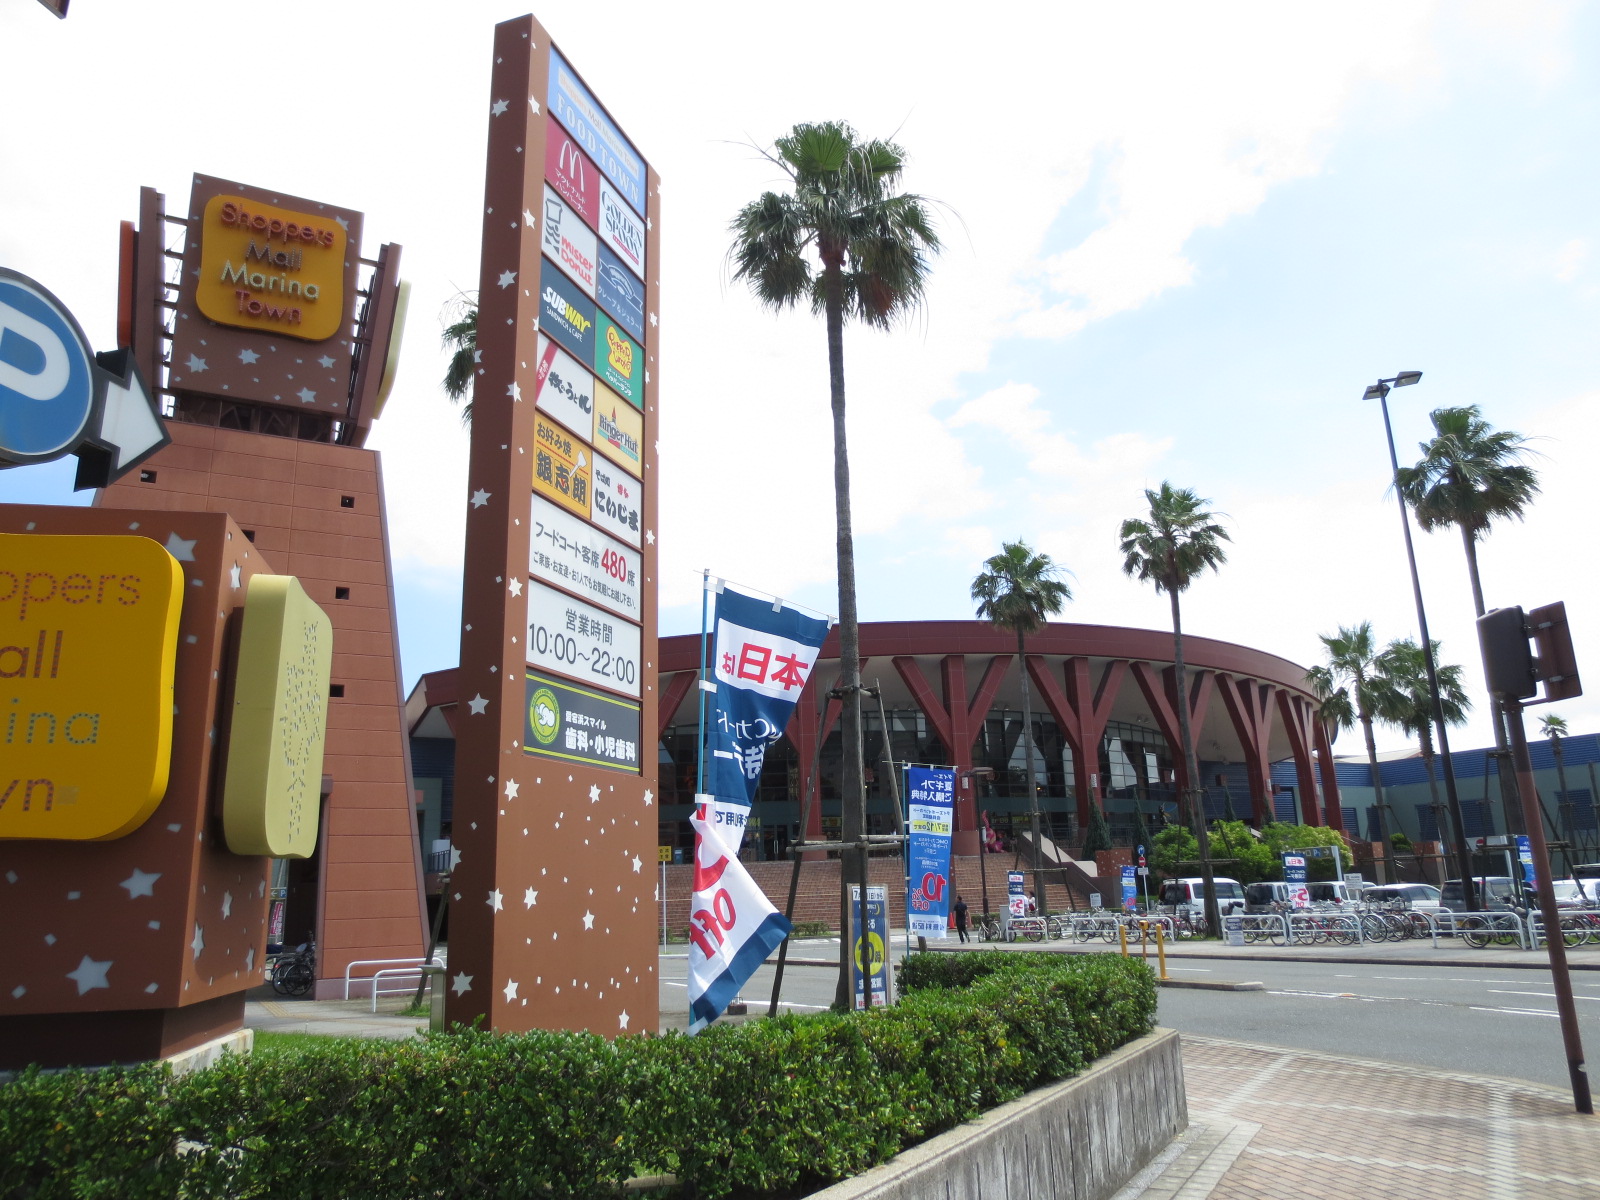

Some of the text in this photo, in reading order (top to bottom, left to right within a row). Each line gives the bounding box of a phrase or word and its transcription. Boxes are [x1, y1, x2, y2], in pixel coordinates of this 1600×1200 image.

[587, 108, 602, 128] Mall
[556, 92, 596, 150] FOOD
[600, 143, 638, 204] TOWN
[221, 202, 335, 248] Shoppers
[602, 190, 642, 248] GOLDEN
[606, 212, 640, 259] SPOON
[246, 240, 302, 271] Mall
[220, 260, 320, 300] Marina
[236, 290, 302, 323] Town
[543, 287, 591, 332] SUBWAY
[546, 306, 568, 330] SANDWICH
[572, 328, 582, 342] CAFE
[536, 422, 572, 458] お好み焼
[599, 412, 624, 444] Ringer
[624, 430, 638, 453] Hut
[595, 488, 638, 532] にいじま
[566, 608, 612, 646] 営業時間
[565, 728, 636, 762] 歯科・小児歯科
